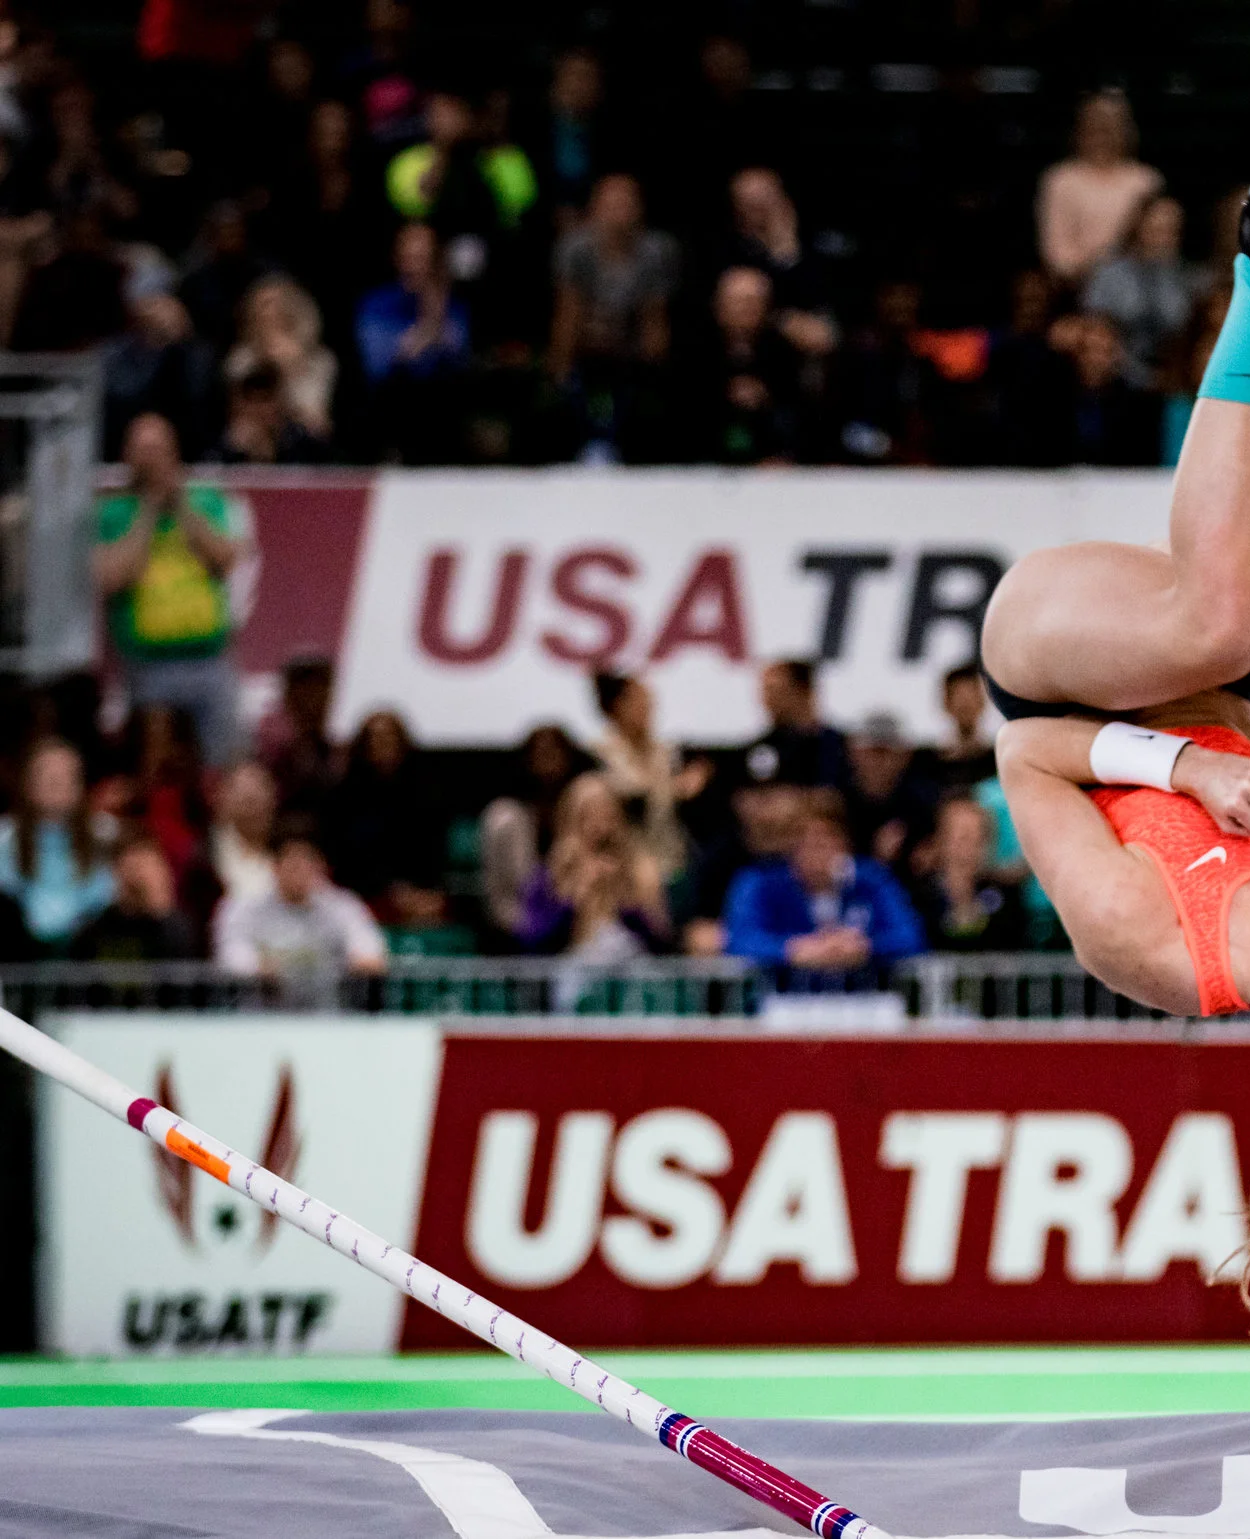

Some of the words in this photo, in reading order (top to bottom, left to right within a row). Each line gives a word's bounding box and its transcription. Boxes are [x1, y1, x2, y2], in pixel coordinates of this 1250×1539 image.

[415, 548, 750, 665] USA
[464, 1107, 858, 1290] USA
[123, 1289, 334, 1348] USATF
